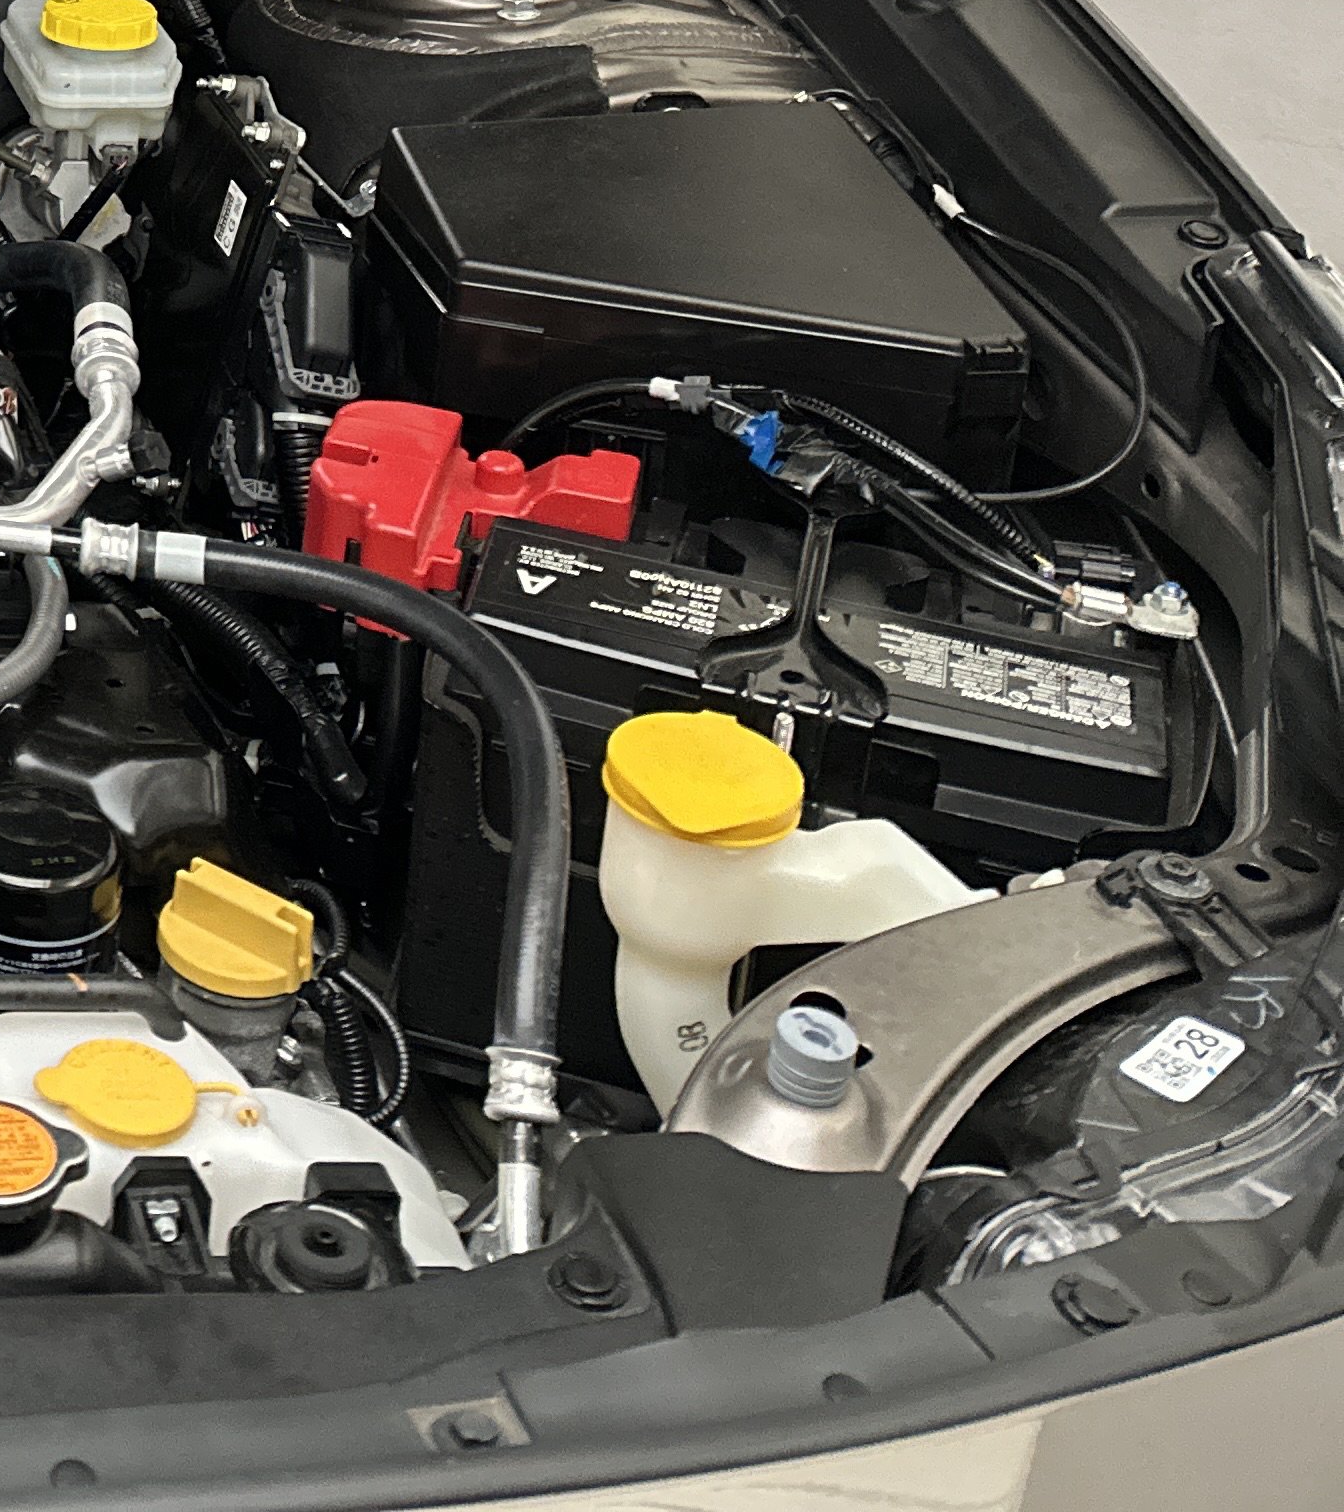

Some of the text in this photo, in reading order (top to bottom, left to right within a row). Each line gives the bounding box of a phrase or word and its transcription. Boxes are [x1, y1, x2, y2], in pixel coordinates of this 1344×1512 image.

[642, 605, 686, 621] AMPS
[681, 622, 714, 635] COLD
[1174, 1028, 1219, 1060] 28
